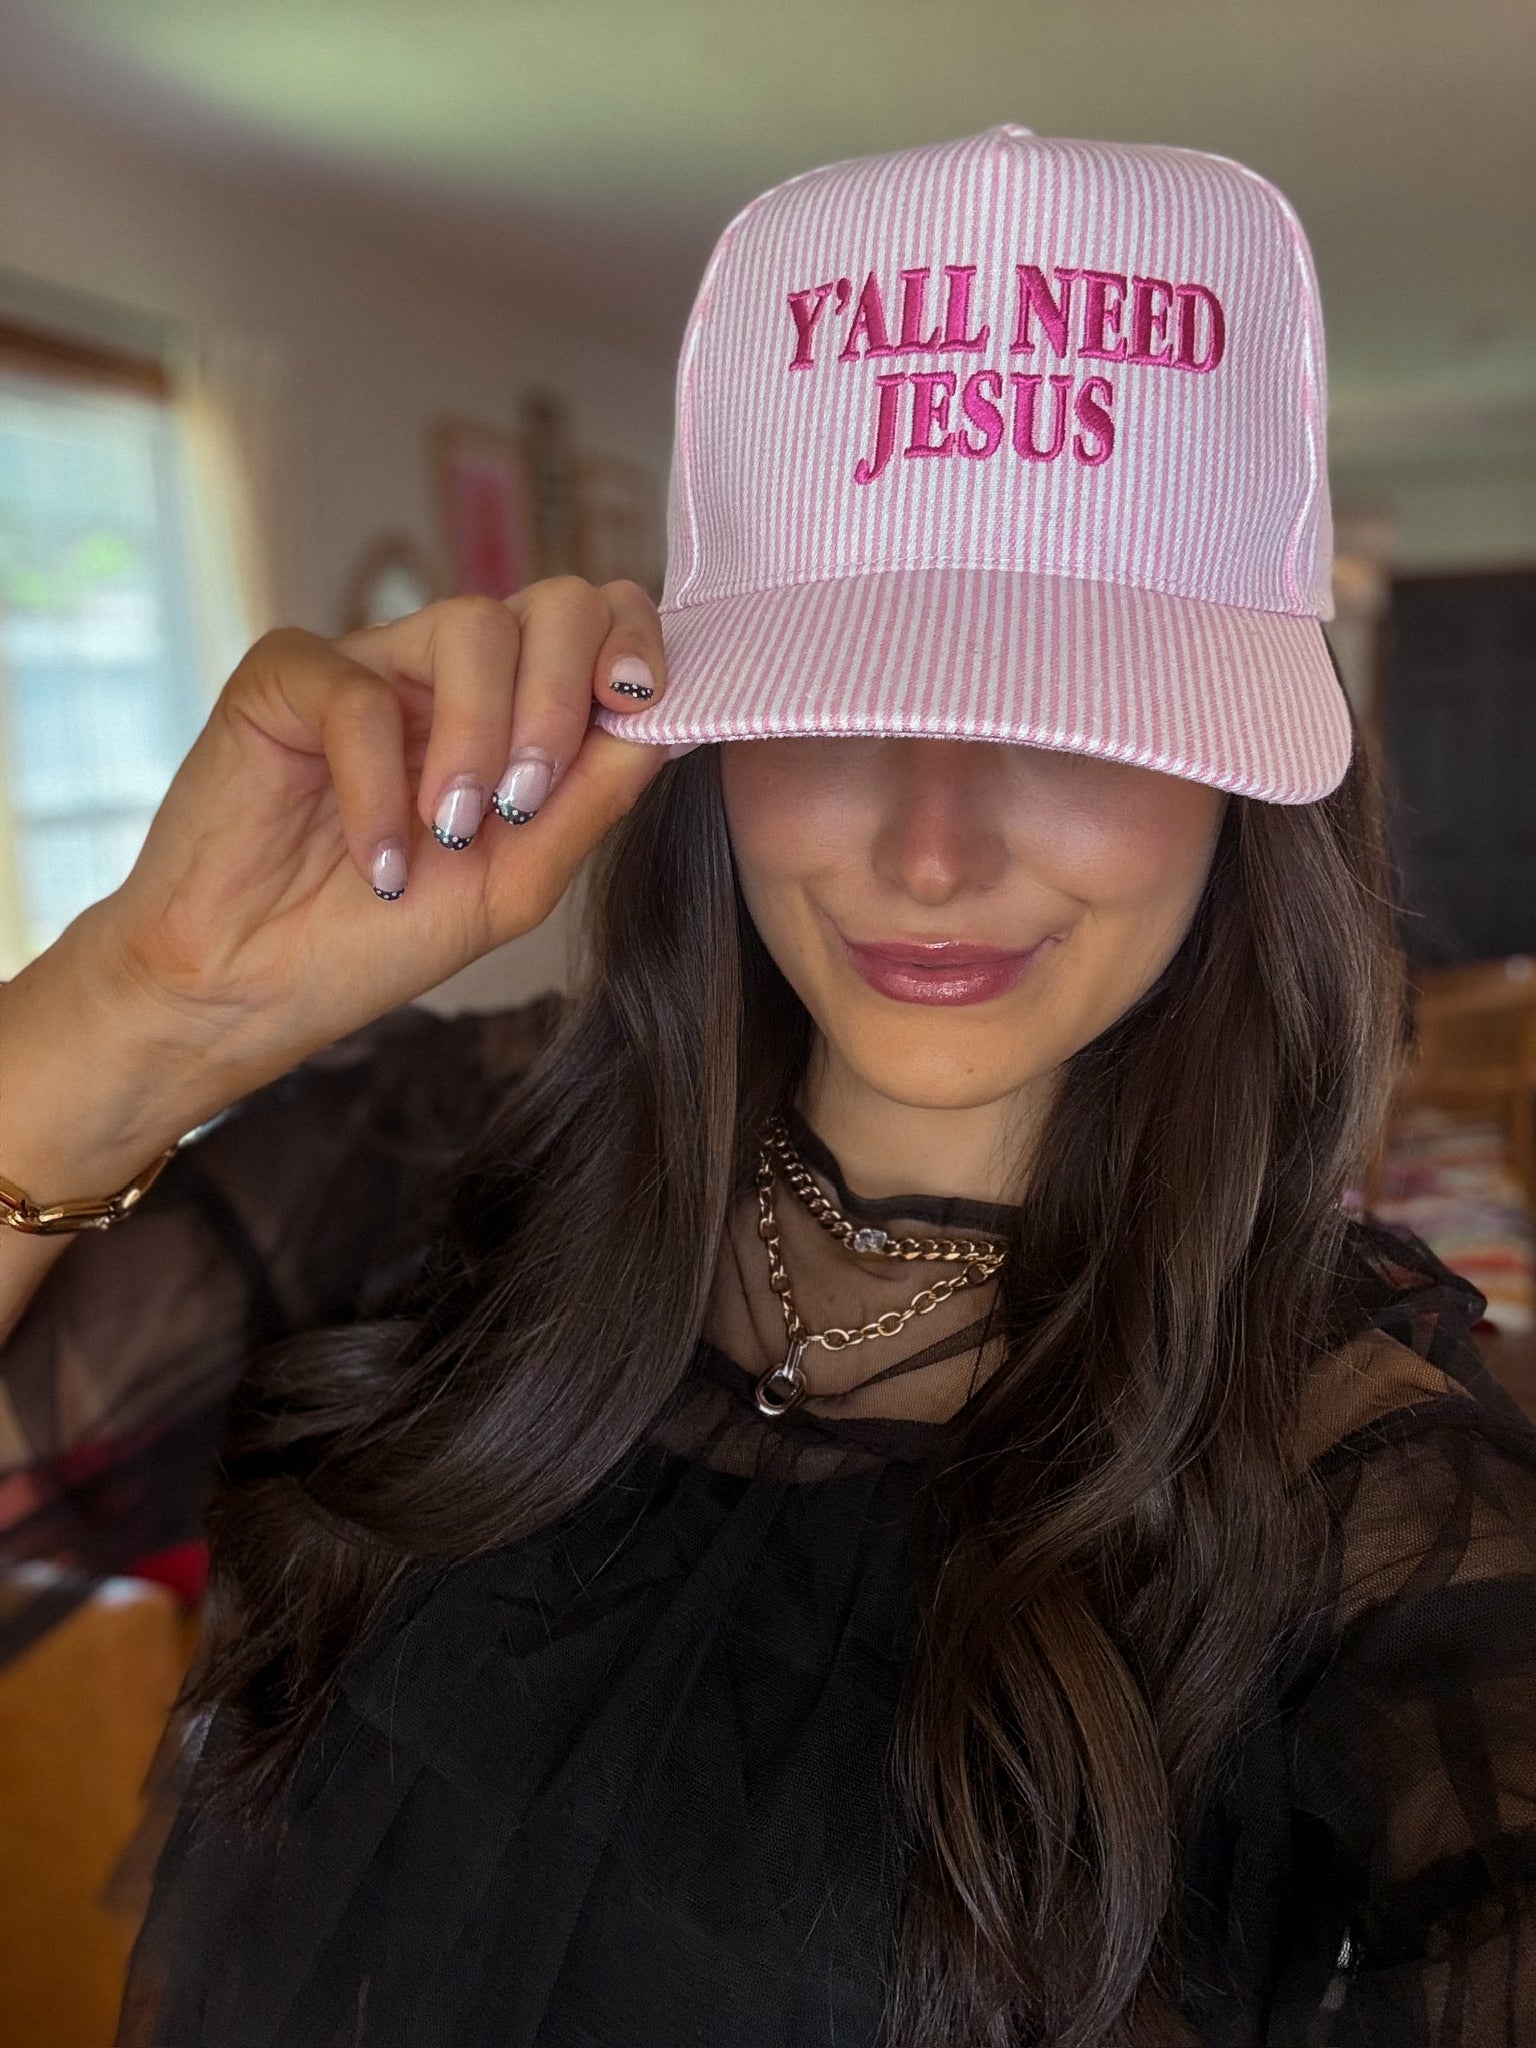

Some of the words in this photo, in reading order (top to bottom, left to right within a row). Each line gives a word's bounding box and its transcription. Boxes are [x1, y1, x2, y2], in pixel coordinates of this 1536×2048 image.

[787, 264, 990, 372] Y'ALL
[1009, 264, 1226, 375] NEED
[854, 369, 1115, 485] JESUS
